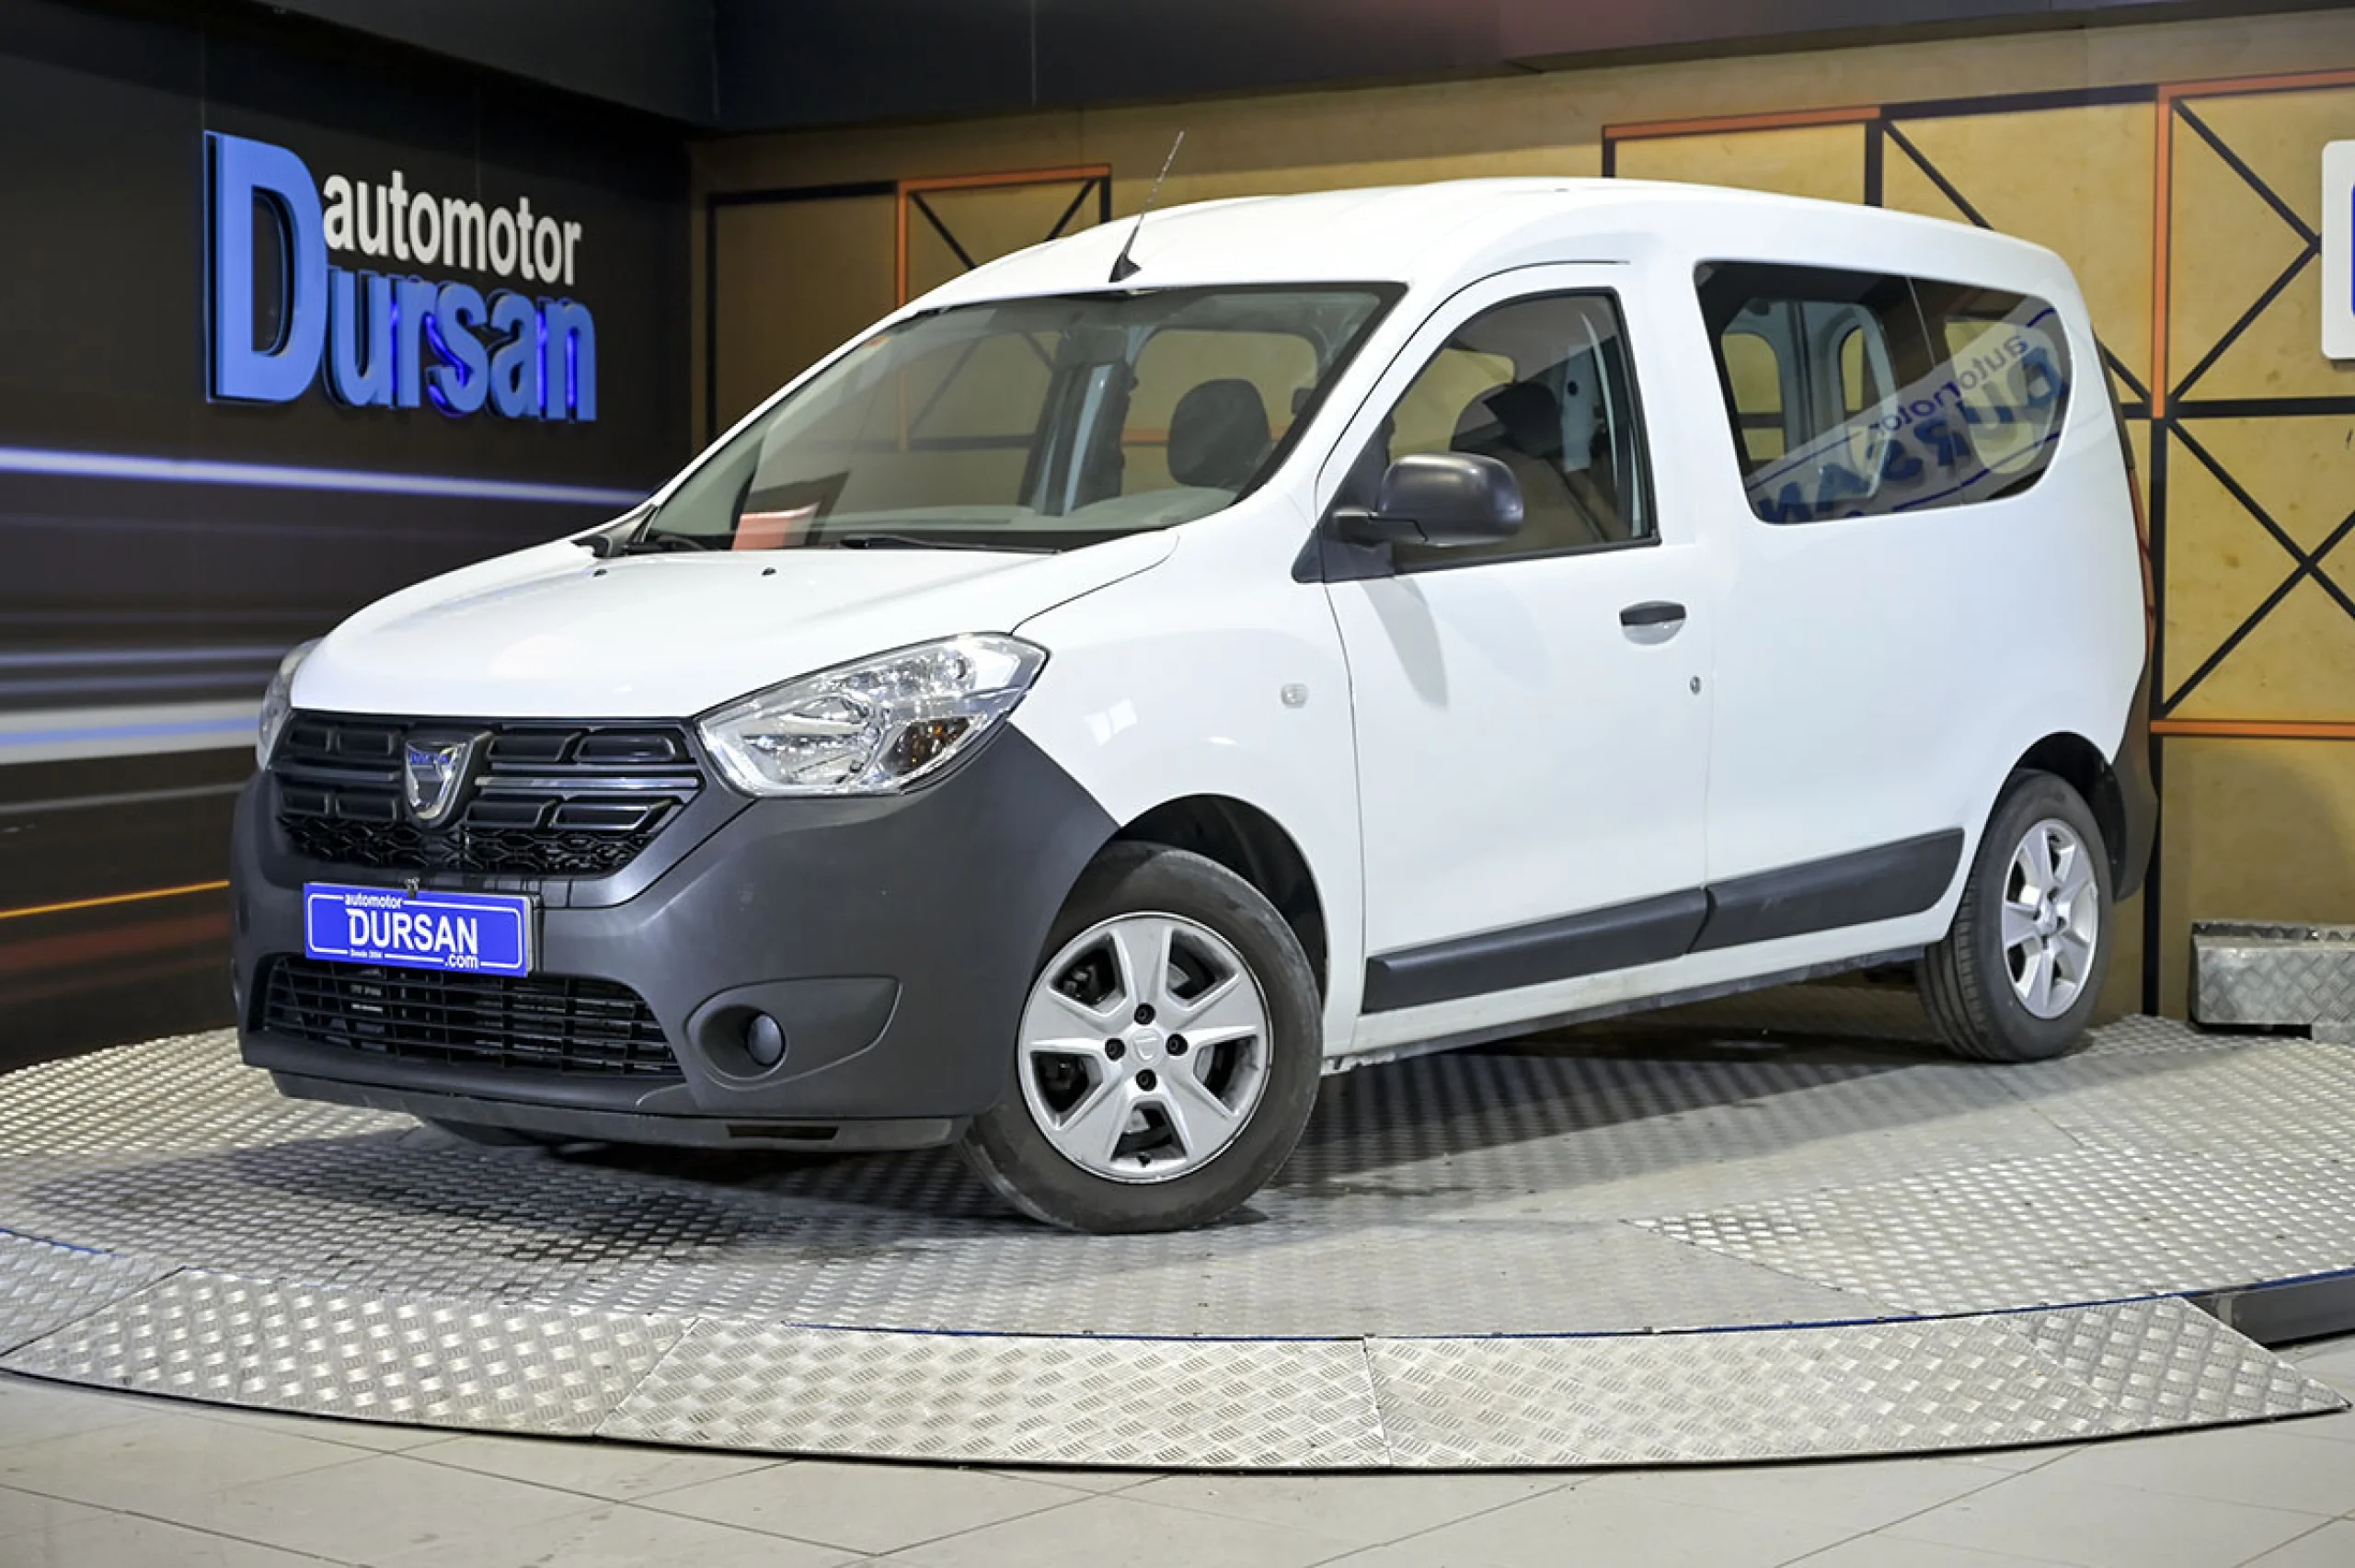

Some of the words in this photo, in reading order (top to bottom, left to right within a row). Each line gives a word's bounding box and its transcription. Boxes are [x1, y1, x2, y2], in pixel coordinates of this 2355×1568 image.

[323, 170, 582, 285] automotor
[204, 130, 597, 422] Dursan
[344, 893, 403, 909] automotor
[345, 908, 477, 955] DURSAN
[444, 953, 479, 969] .com
